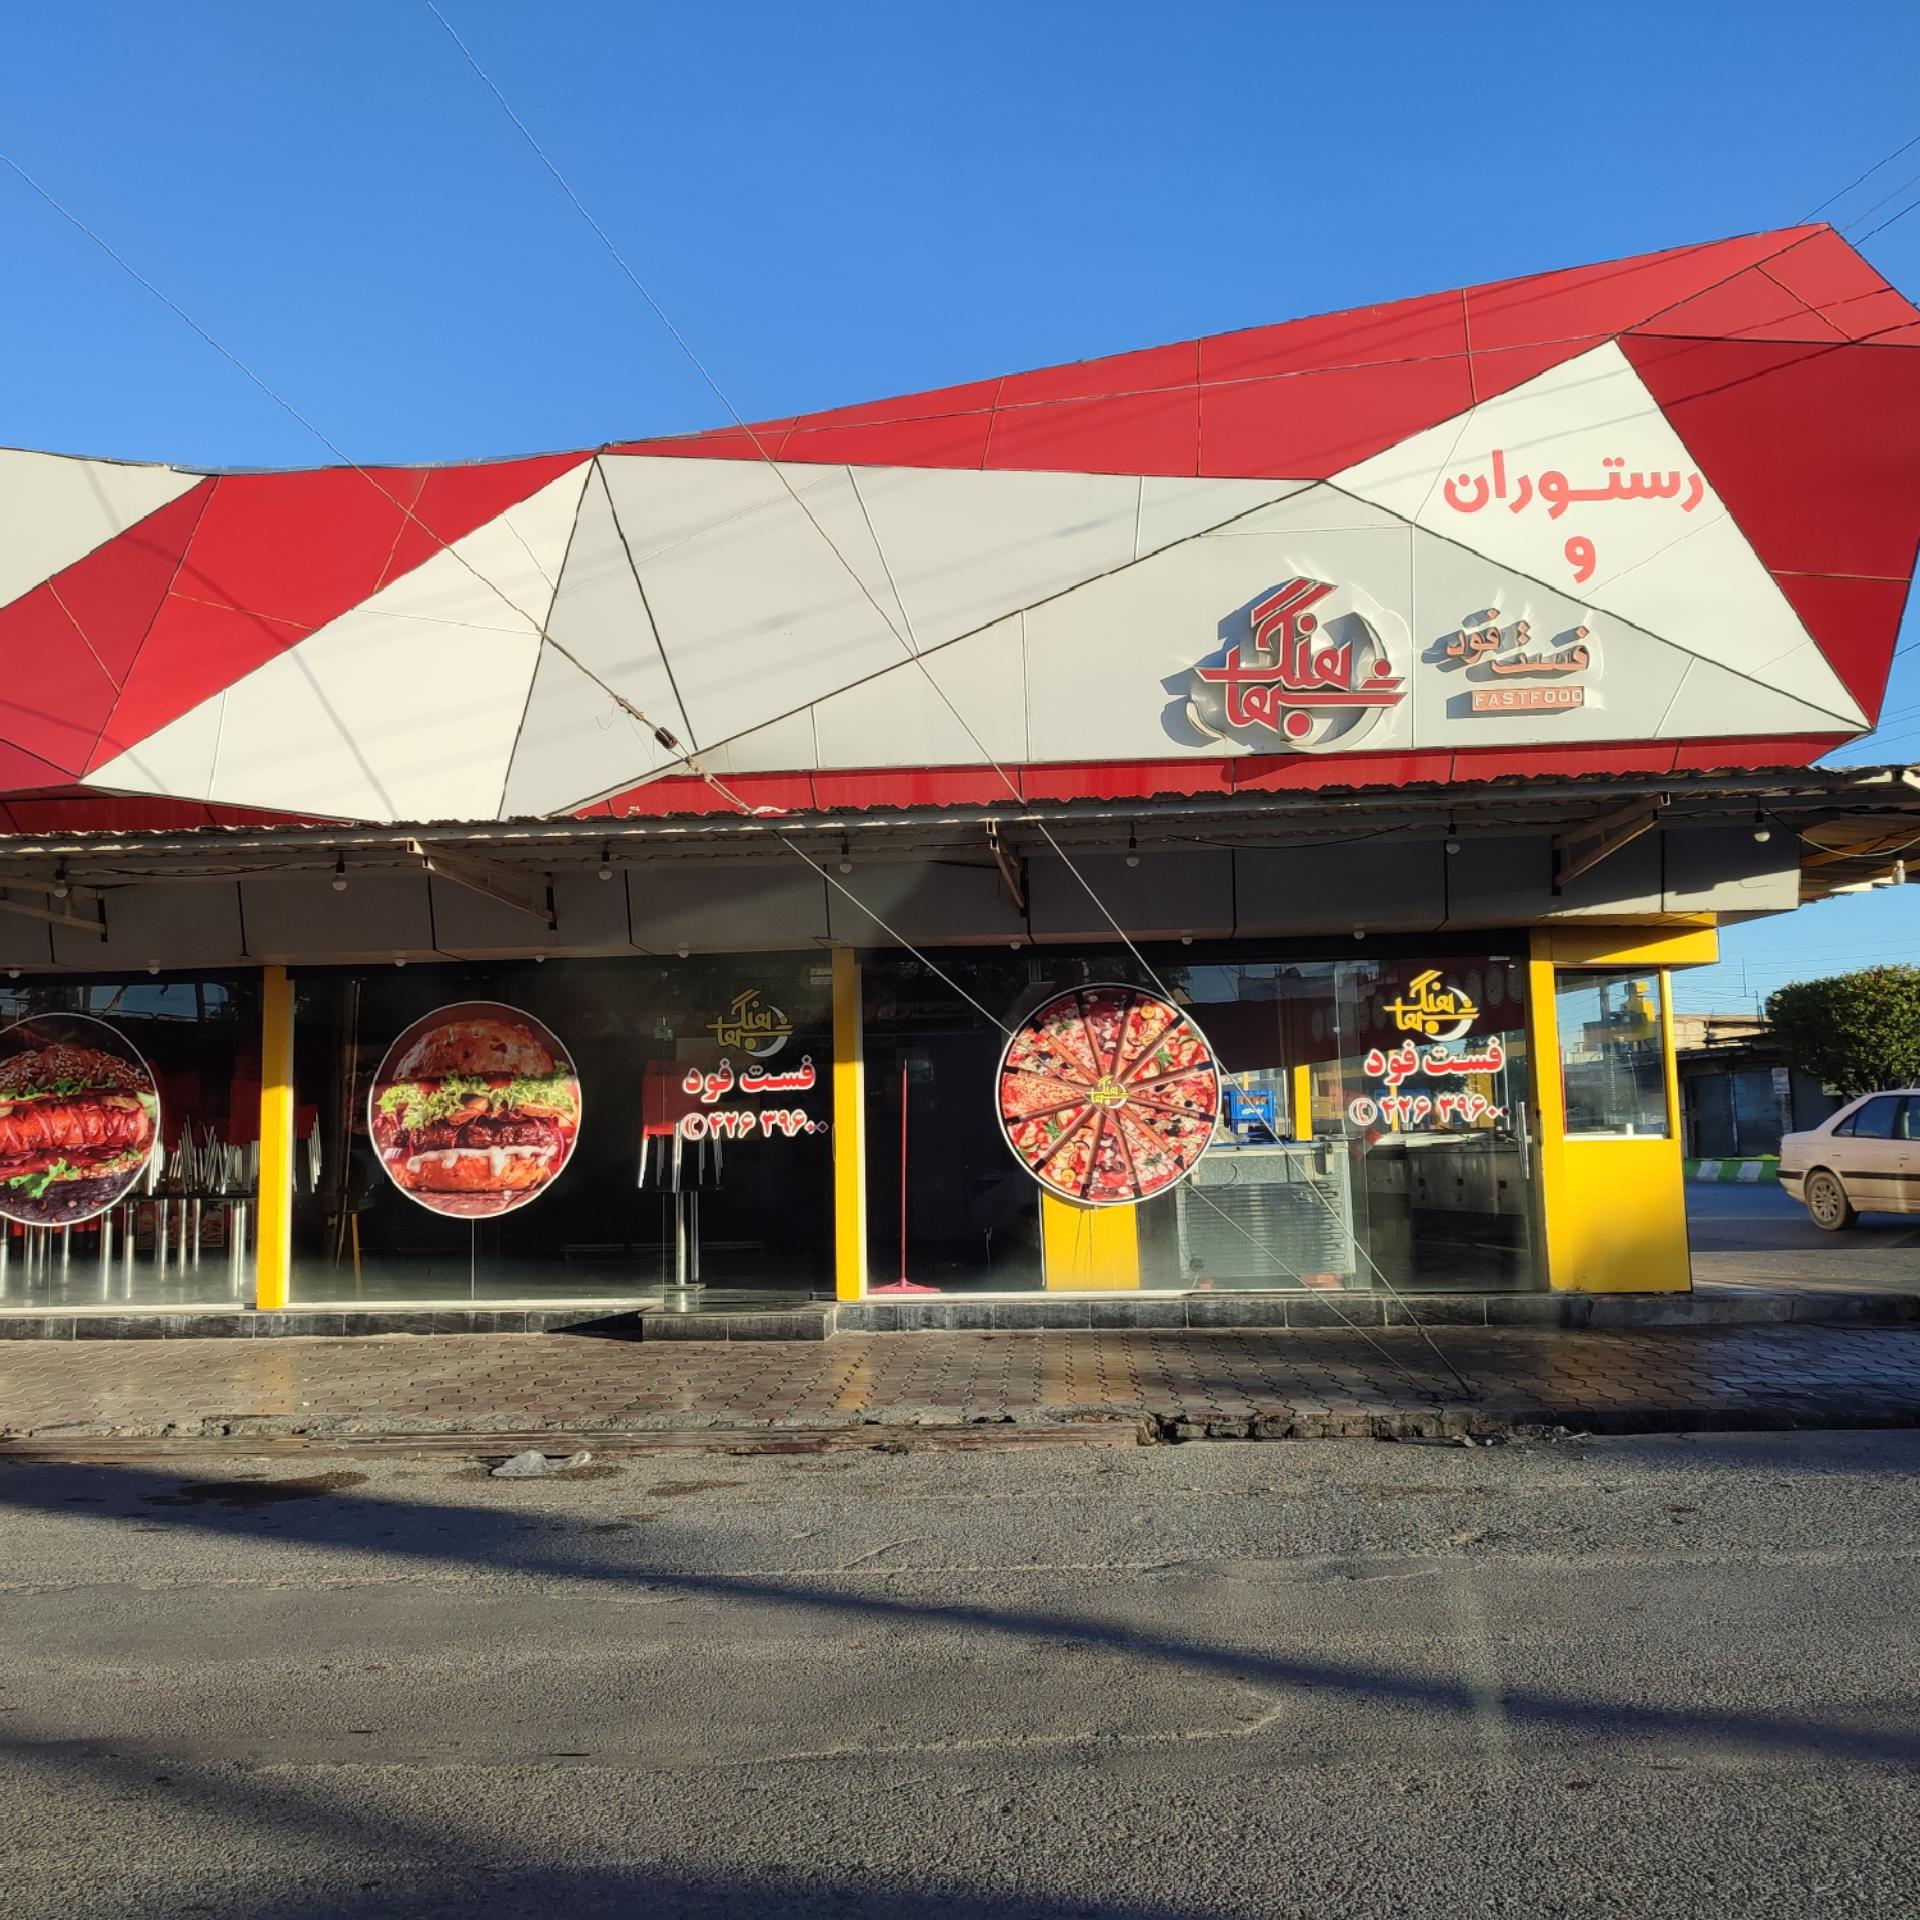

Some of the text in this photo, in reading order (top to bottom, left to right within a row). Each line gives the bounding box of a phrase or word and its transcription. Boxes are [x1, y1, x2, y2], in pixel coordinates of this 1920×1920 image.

[1444, 450, 1704, 518] رستوران
[1564, 535, 1597, 583] و
[1446, 607, 1590, 674] فست فود
[1474, 689, 1583, 707] FASTFOOD
[682, 1055, 816, 1103] فست فود
[1365, 1036, 1506, 1086] فست فود
[708, 1110, 756, 1139] ۴۲۶
[1379, 1095, 1431, 1124] ۴۲۶
